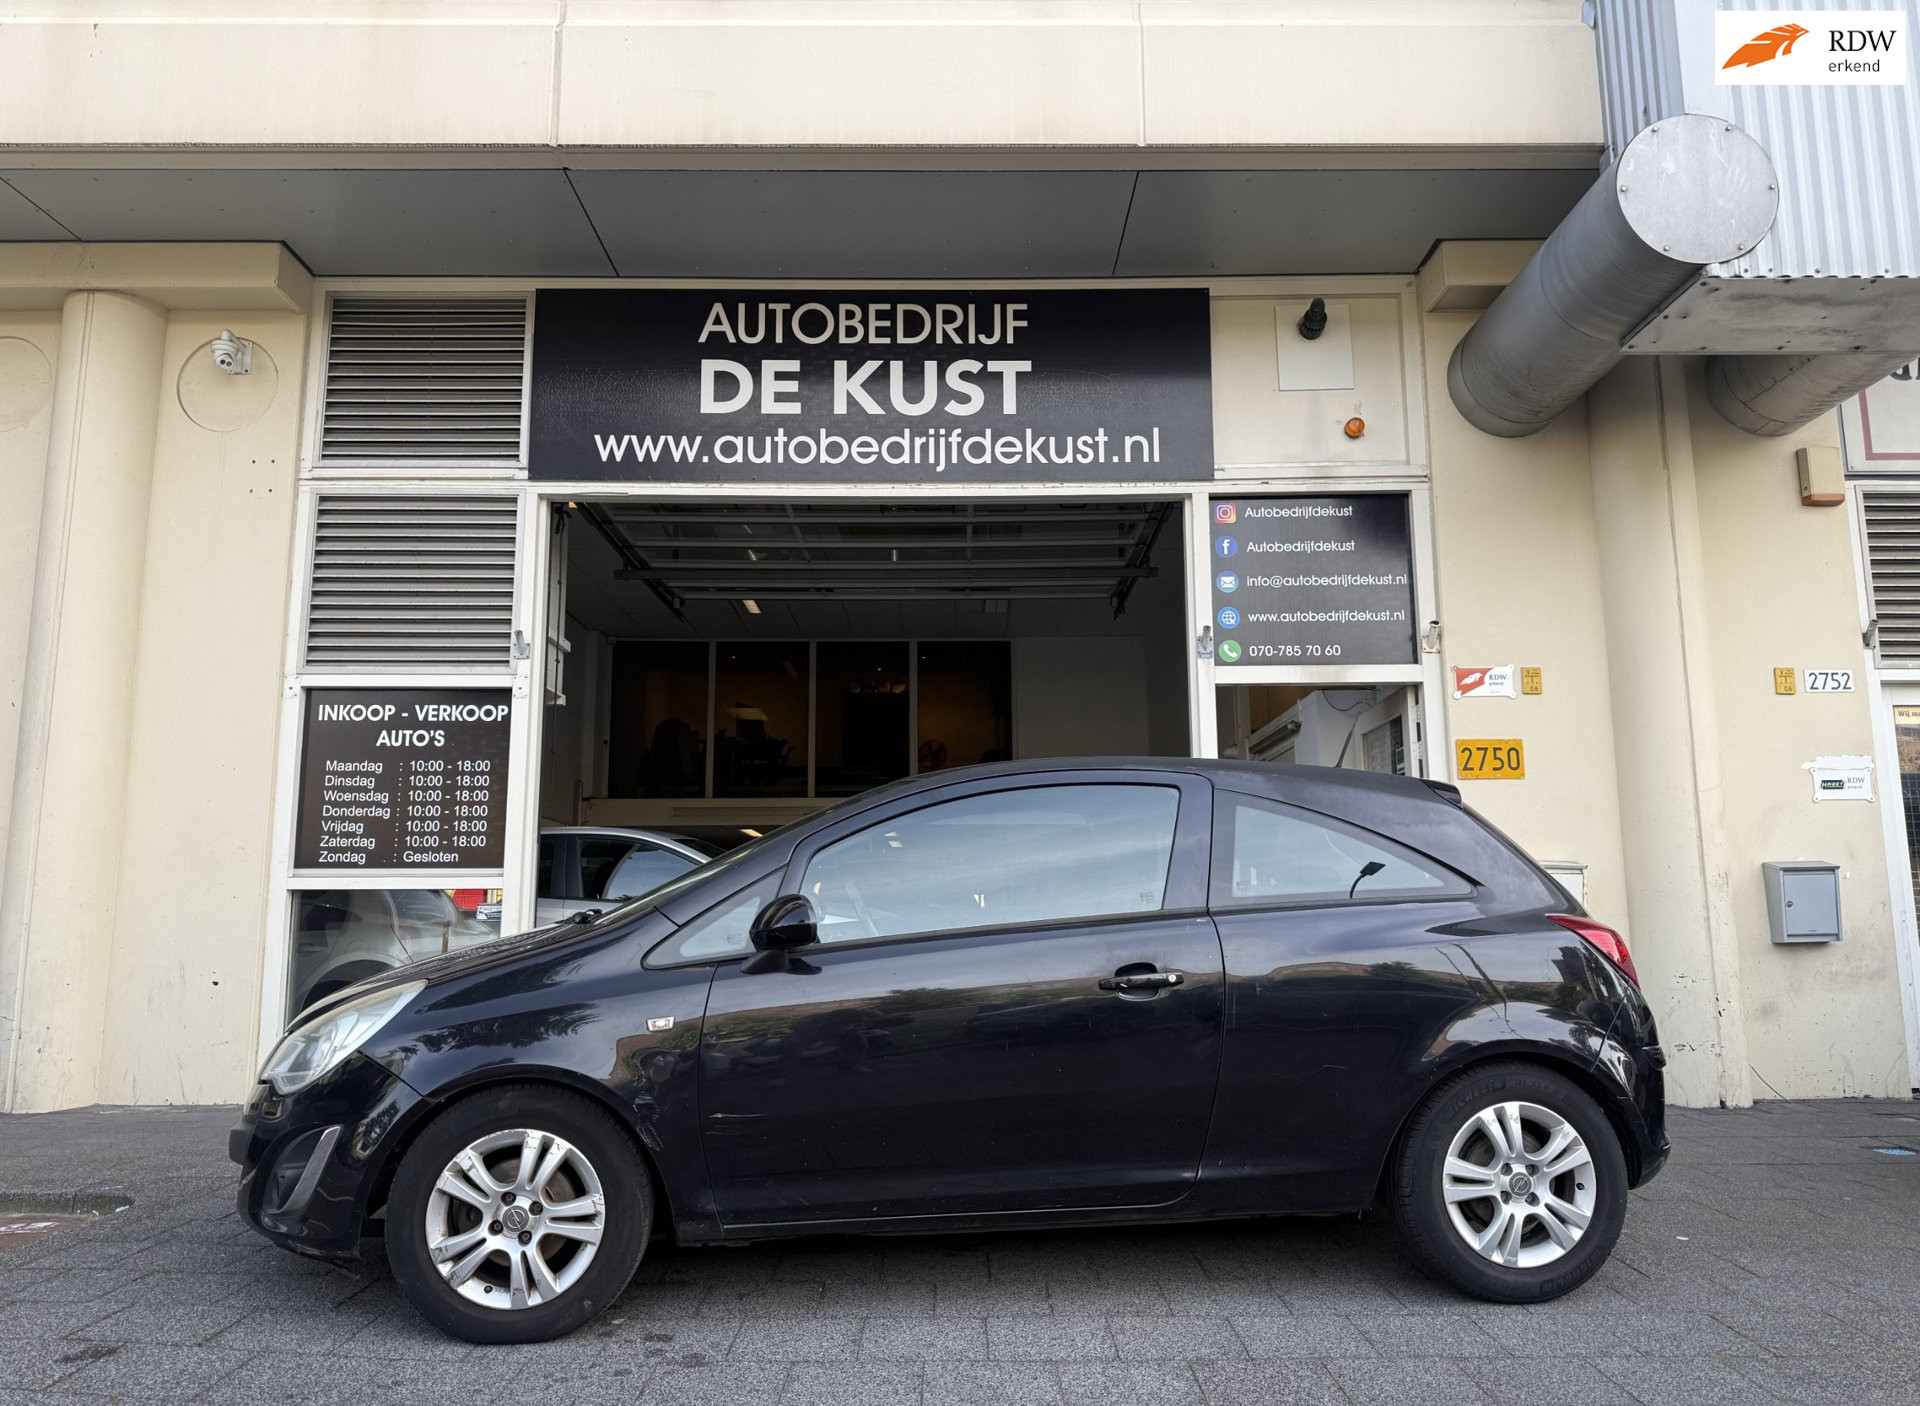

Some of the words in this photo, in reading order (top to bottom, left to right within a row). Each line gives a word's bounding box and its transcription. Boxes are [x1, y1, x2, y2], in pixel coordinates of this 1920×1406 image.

[698, 303, 1028, 345] AUTOBEDRIJF
[700, 360, 801, 415] DE
[834, 360, 1031, 415] KUST
[594, 428, 1159, 471] www.autobedrijfdekust.nl
[1245, 506, 1353, 519] Autobedrijfdekust
[1247, 540, 1355, 553] Autobedrijfdekust
[1247, 574, 1407, 588] info@autobedrijfdekust.nl
[1248, 610, 1404, 623] www.autobedrijfdekust.nl
[1249, 646, 1301, 656] 070-785
[1306, 646, 1321, 656] 70
[1325, 645, 1341, 655] 60
[1809, 673, 1851, 690] 2752
[318, 705, 396, 721] INKOOP
[415, 705, 509, 721] VERKOOP
[376, 730, 445, 746] AUTO'S
[1461, 747, 1520, 771] 2750
[326, 760, 383, 773] Maandag
[410, 761, 443, 771] 10:00
[457, 761, 491, 771] 18:00
[325, 776, 375, 788] Dinsdag
[409, 776, 442, 786] 10:00
[456, 776, 490, 786] 18:00
[324, 791, 388, 803] Woensdag
[408, 791, 442, 801] 10:00
[455, 791, 489, 801] 18:00
[323, 806, 390, 818] Donderdag
[407, 806, 441, 816] 10:00
[454, 806, 488, 816] 18:00
[322, 821, 363, 834] Vrijdag
[406, 821, 440, 832] 10:00
[453, 821, 487, 832] 18:00
[320, 836, 375, 849] Zaterdag
[405, 836, 439, 846] 10:00
[452, 836, 486, 846] 18:00
[319, 852, 366, 864] Zondag
[403, 852, 458, 862] Gesloten
